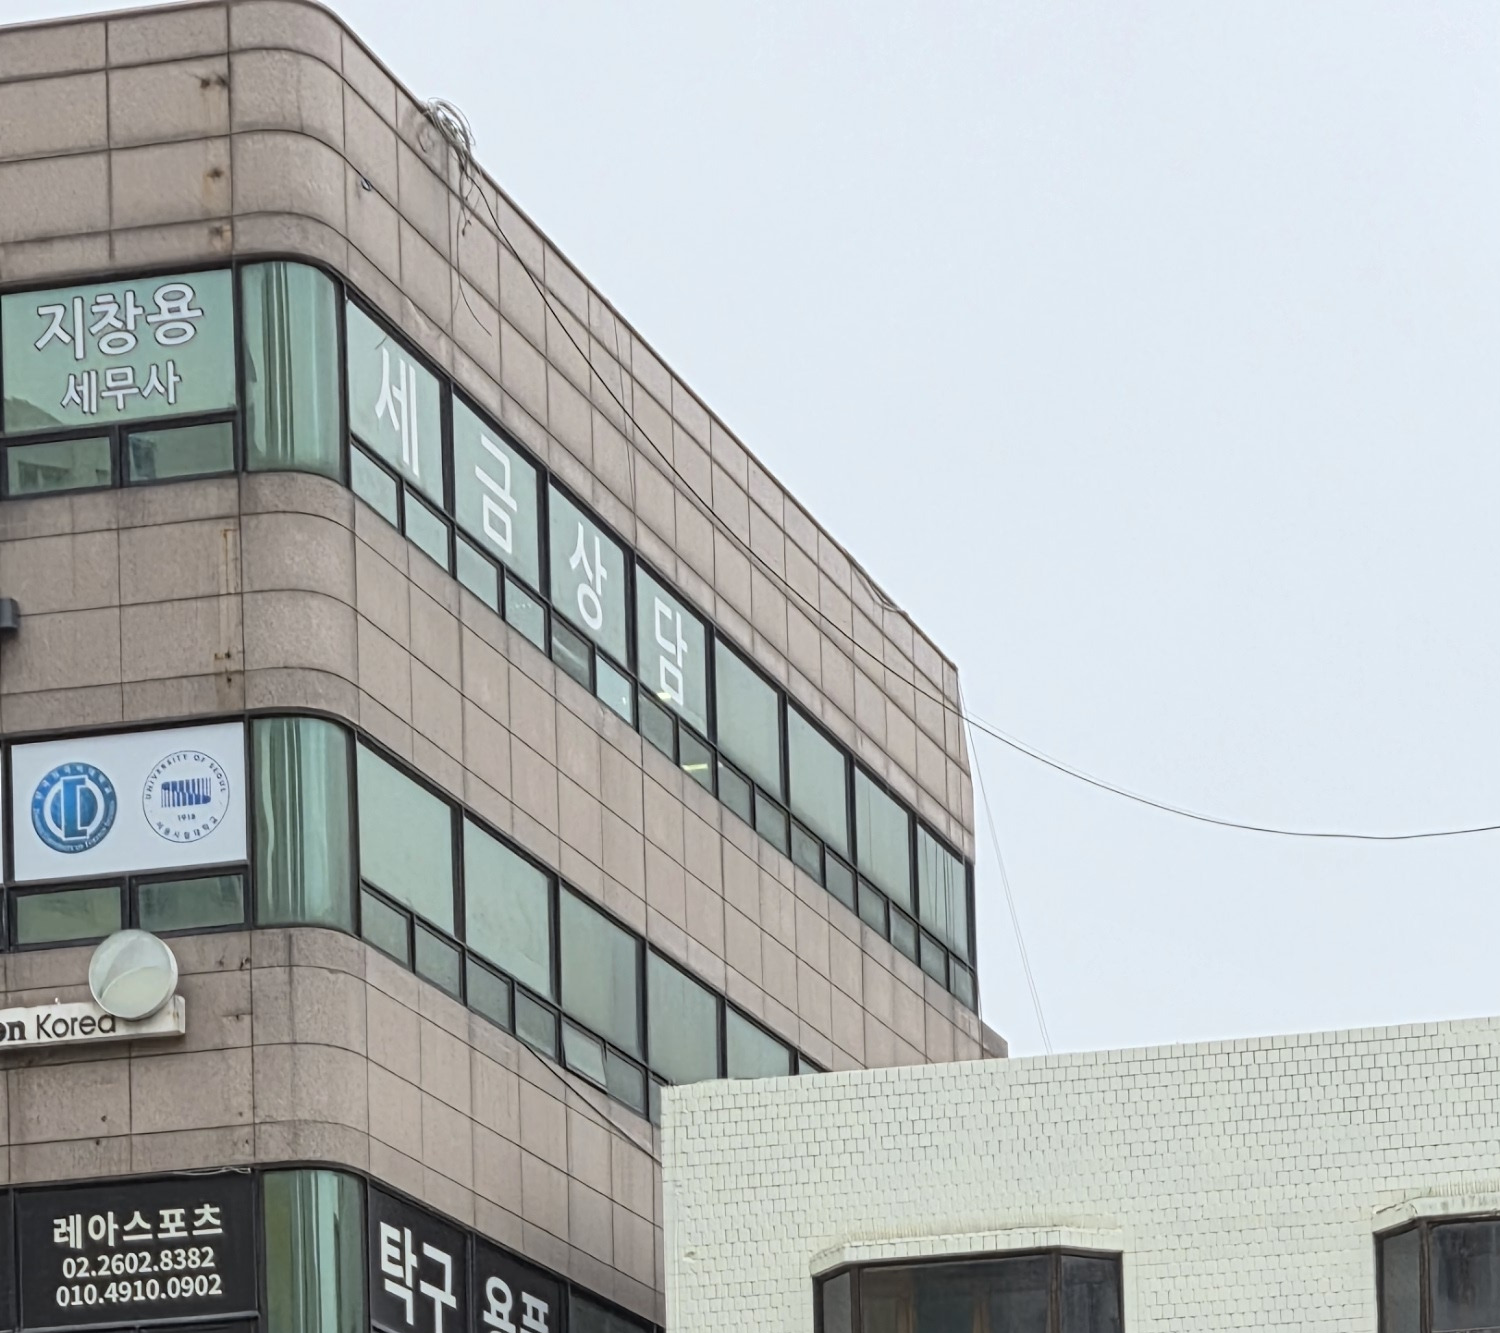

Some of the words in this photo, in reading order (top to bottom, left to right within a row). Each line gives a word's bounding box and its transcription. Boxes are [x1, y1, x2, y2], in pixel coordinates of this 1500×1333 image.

[34, 282, 205, 361] 지창용
[60, 361, 182, 414] 세무사
[36, 1012, 117, 1040] Korea
[52, 1202, 223, 1246] 레아스포츠
[61, 1246, 216, 1280] 02.2602.8382
[55, 1274, 222, 1308] 010.4910.0902
